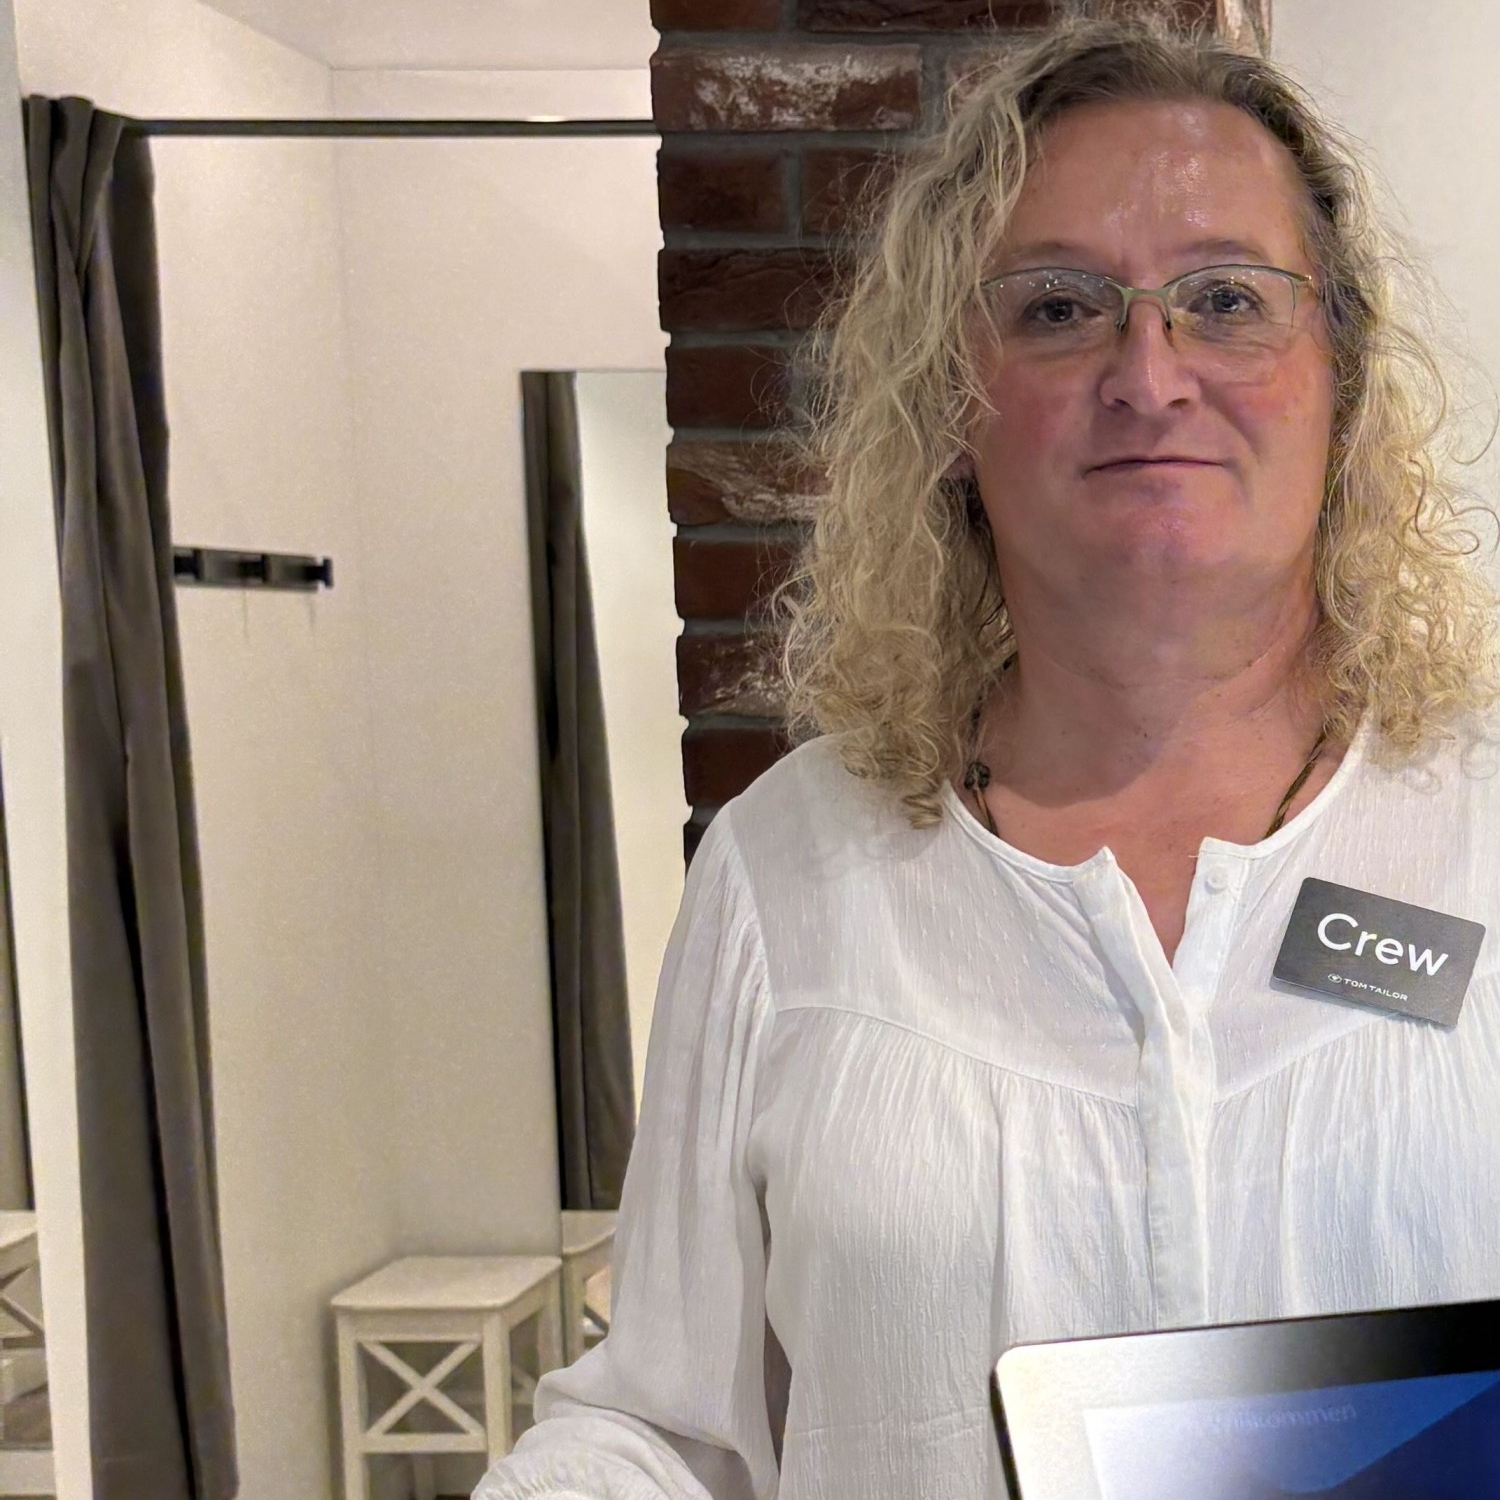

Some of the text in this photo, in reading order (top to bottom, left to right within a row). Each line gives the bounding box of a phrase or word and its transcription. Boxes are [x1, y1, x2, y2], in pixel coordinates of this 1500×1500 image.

[1316, 912, 1449, 976] Crew
[1344, 978, 1409, 1002] TOM TAILOR
